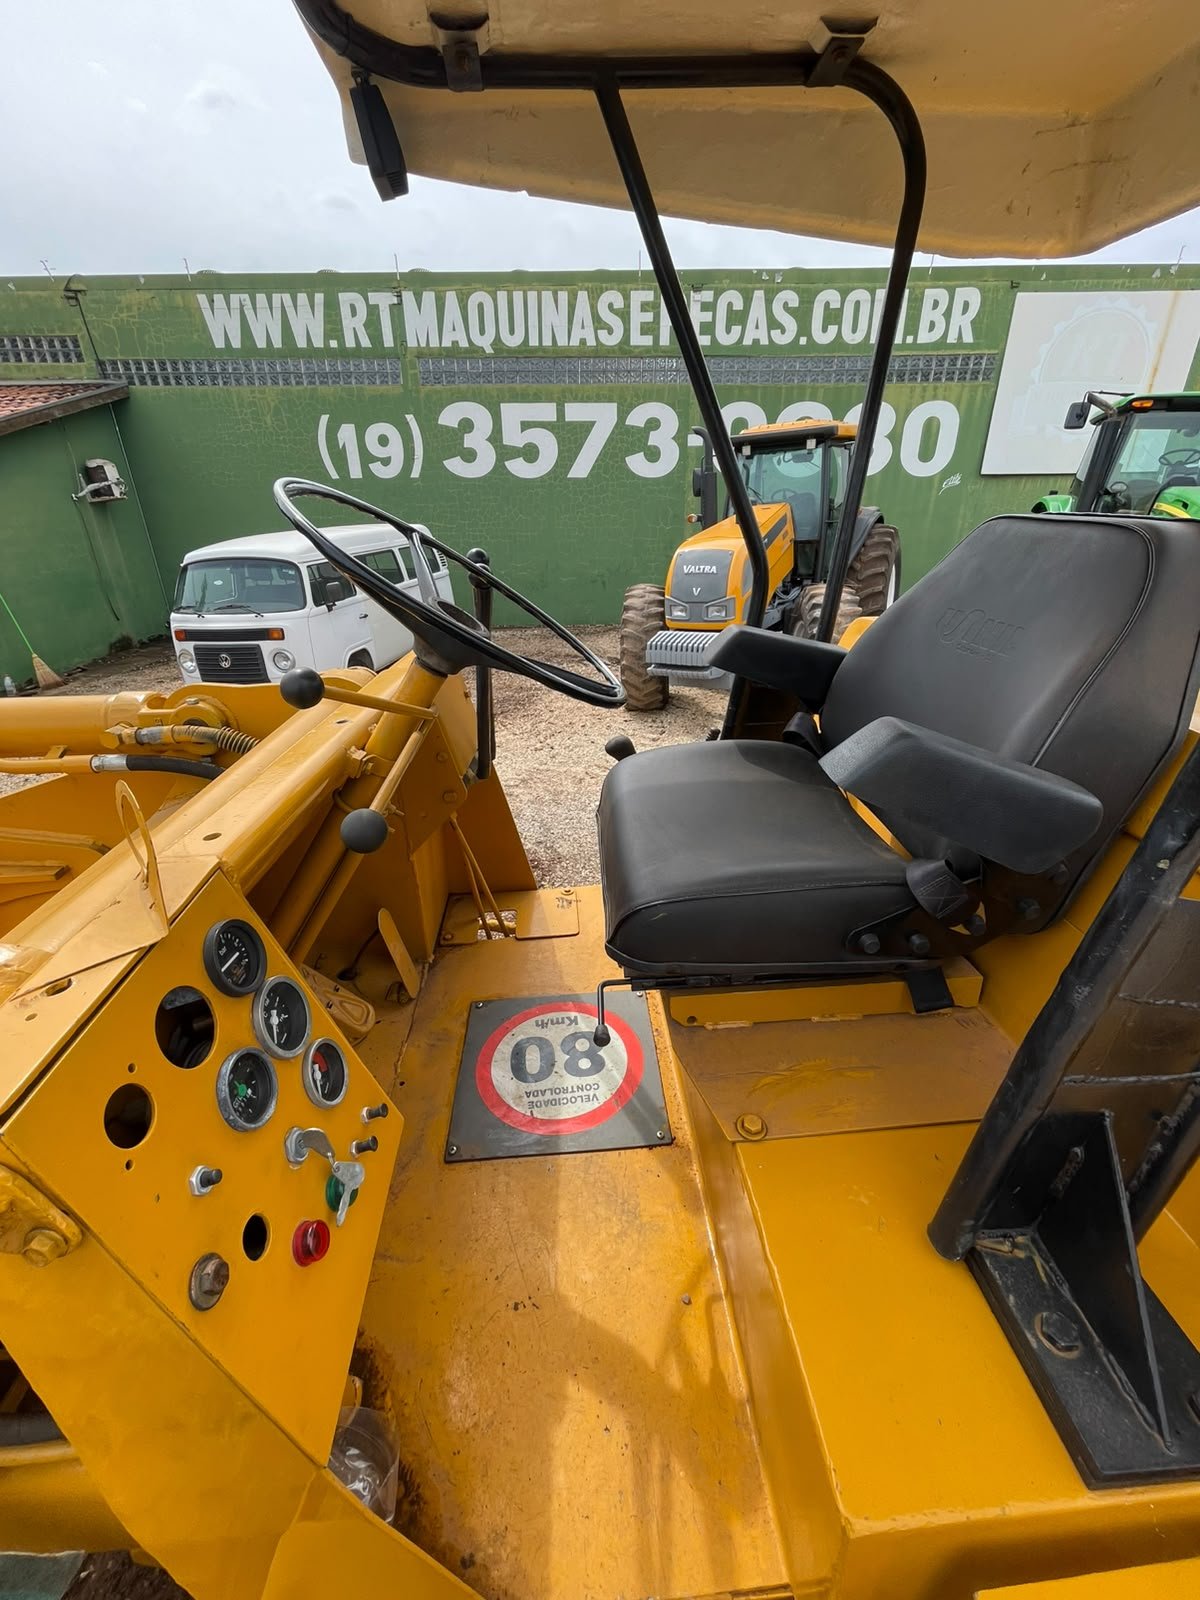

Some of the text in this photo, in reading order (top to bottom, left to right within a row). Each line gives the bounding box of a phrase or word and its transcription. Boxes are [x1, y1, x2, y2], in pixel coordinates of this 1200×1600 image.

[317, 414, 424, 479] (19)
[683, 565, 717, 574] VALTRA
[532, 1015, 579, 1029] Km/h
[510, 1031, 606, 1083] 80
[524, 1082, 600, 1098] CONTROLADA
[527, 1094, 599, 1109] VELOCIDADE
